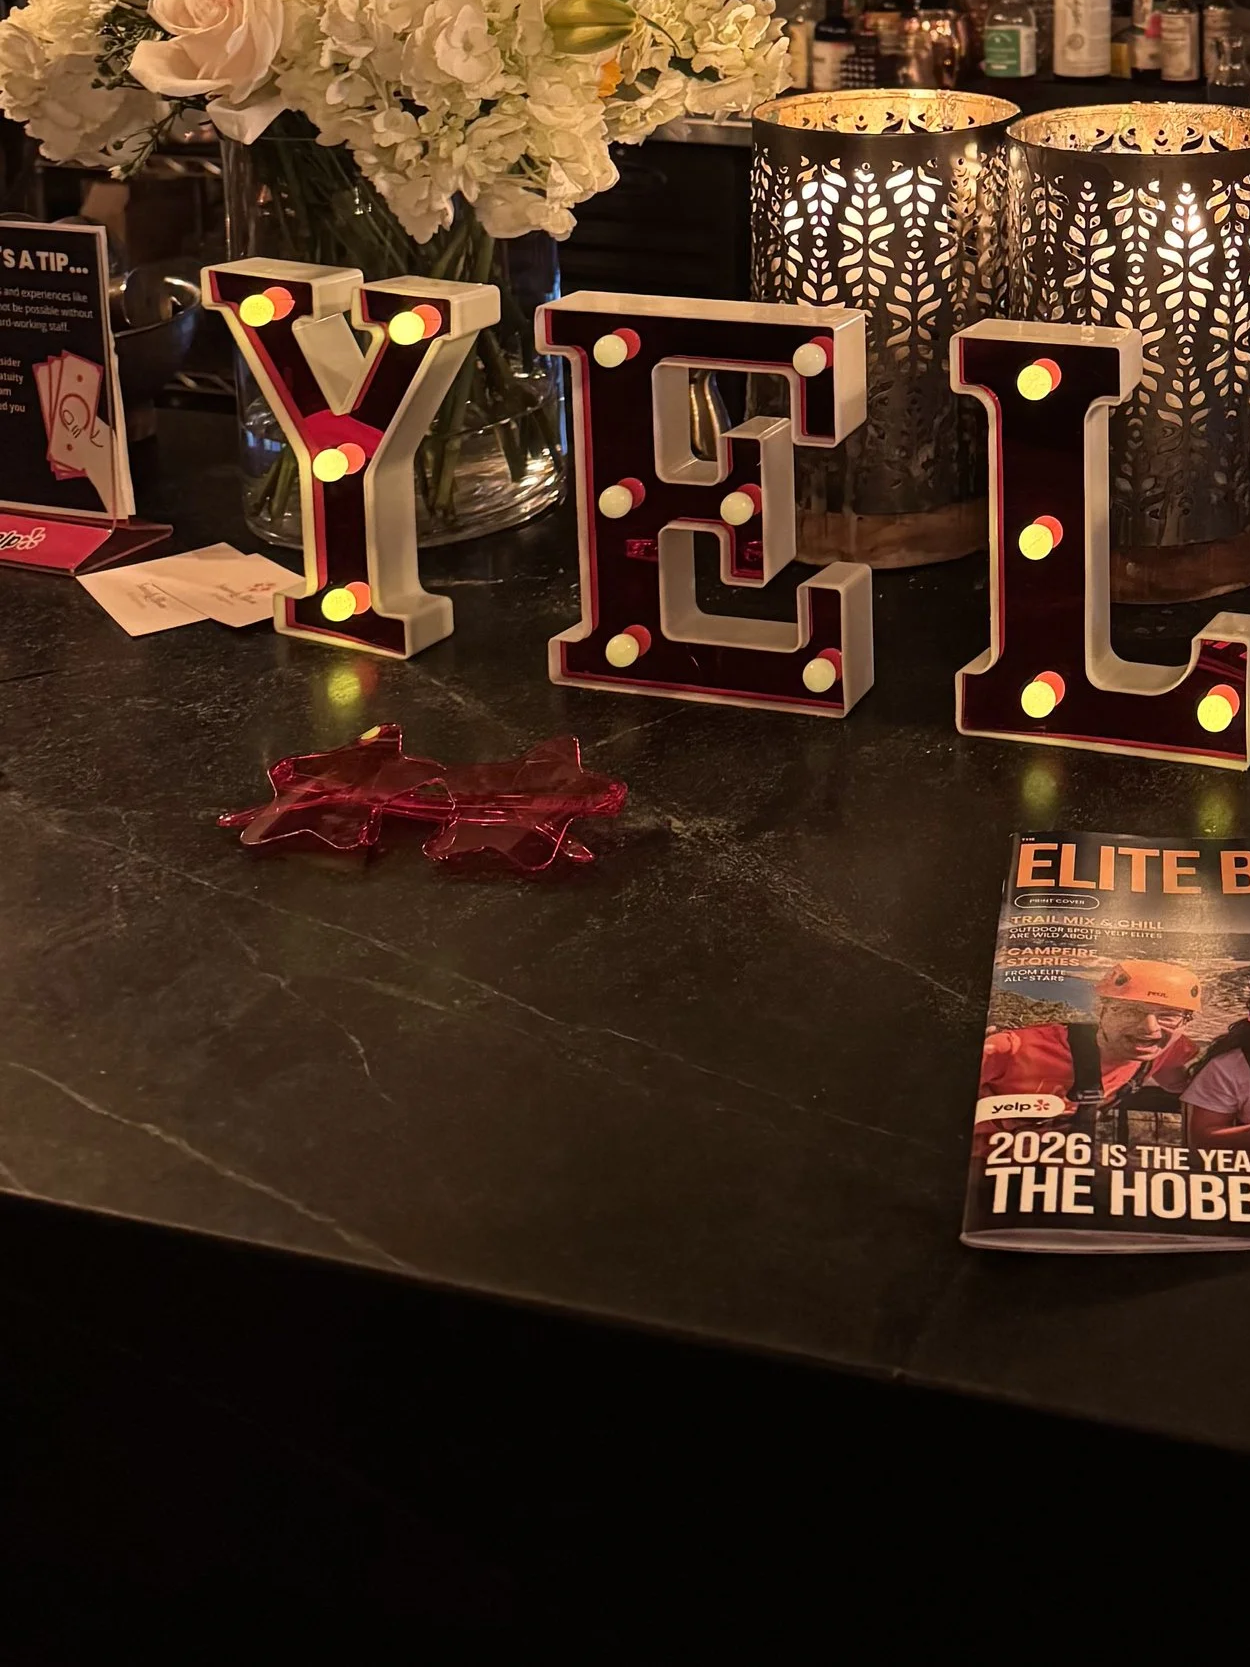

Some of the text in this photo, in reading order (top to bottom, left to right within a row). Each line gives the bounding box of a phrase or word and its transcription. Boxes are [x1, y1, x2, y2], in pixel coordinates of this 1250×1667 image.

[19, 250, 35, 270] A
[4, 287, 88, 303] and experiences like
[13, 302, 23, 313] be
[25, 305, 60, 316] possible
[61, 308, 94, 319] without
[9, 404, 26, 414] you
[1016, 842, 1202, 894] ELITE
[1010, 915, 1165, 930] TRAIL MIX & CHILL
[1067, 927, 1101, 935] SPOTS
[1130, 931, 1163, 939] ELITES
[1007, 947, 1098, 958] CAMPFIRE
[1006, 957, 1080, 967] STORIES
[991, 1100, 1032, 1114] yelp
[986, 1131, 1092, 1166] 2026
[1101, 1143, 1127, 1168] IS
[1135, 1145, 1190, 1171] THE
[984, 1166, 1096, 1215] THE
